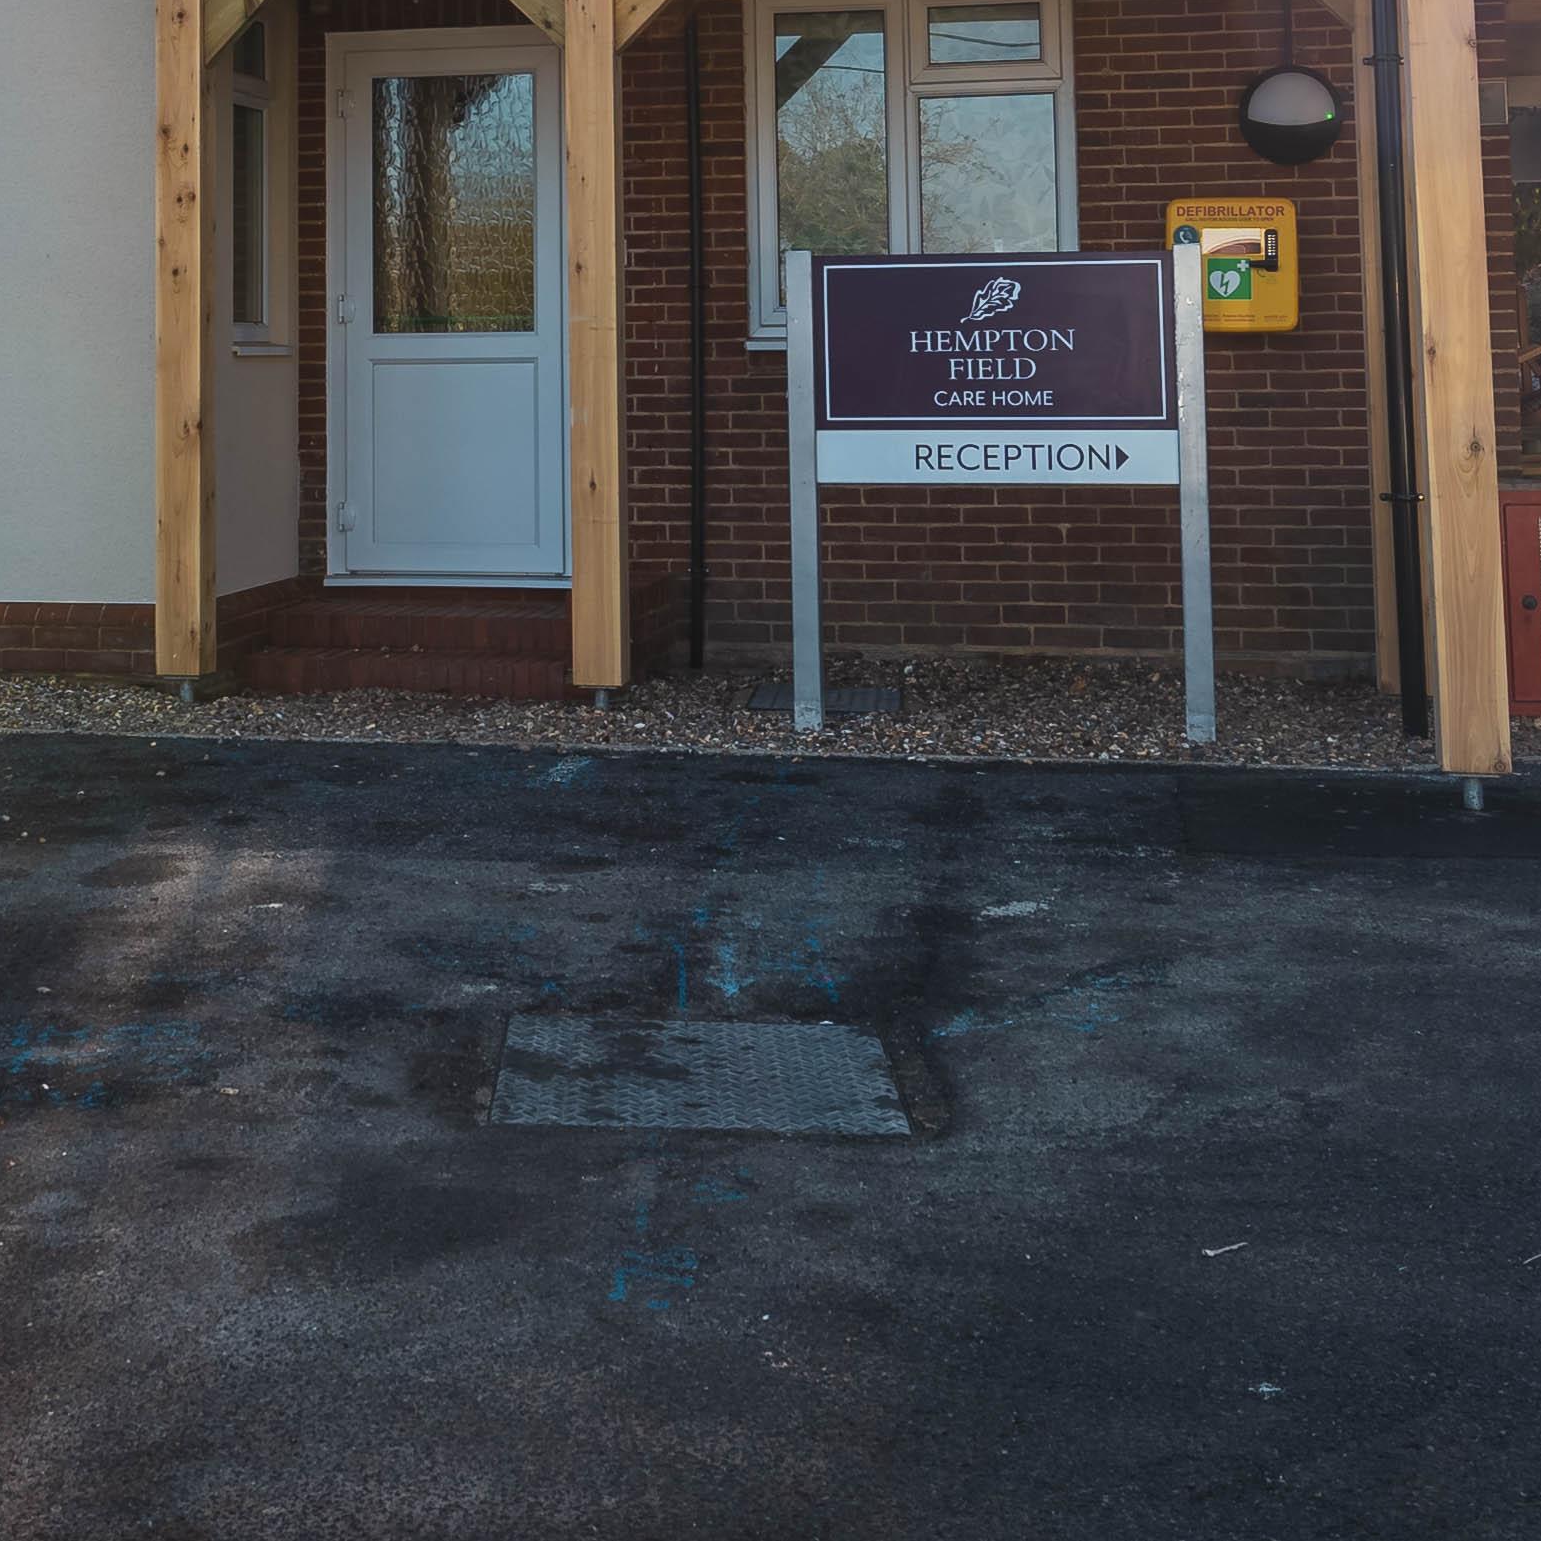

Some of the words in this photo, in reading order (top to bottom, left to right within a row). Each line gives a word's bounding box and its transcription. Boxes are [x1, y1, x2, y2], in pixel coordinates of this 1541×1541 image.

[1176, 206, 1285, 216] DEFIBRILLATOR
[910, 329, 1075, 352] HEMPTON
[949, 358, 1037, 380] FIELD
[934, 390, 986, 406] CARE
[993, 390, 1053, 406] HOME
[915, 444, 1110, 471] RECEPTION
